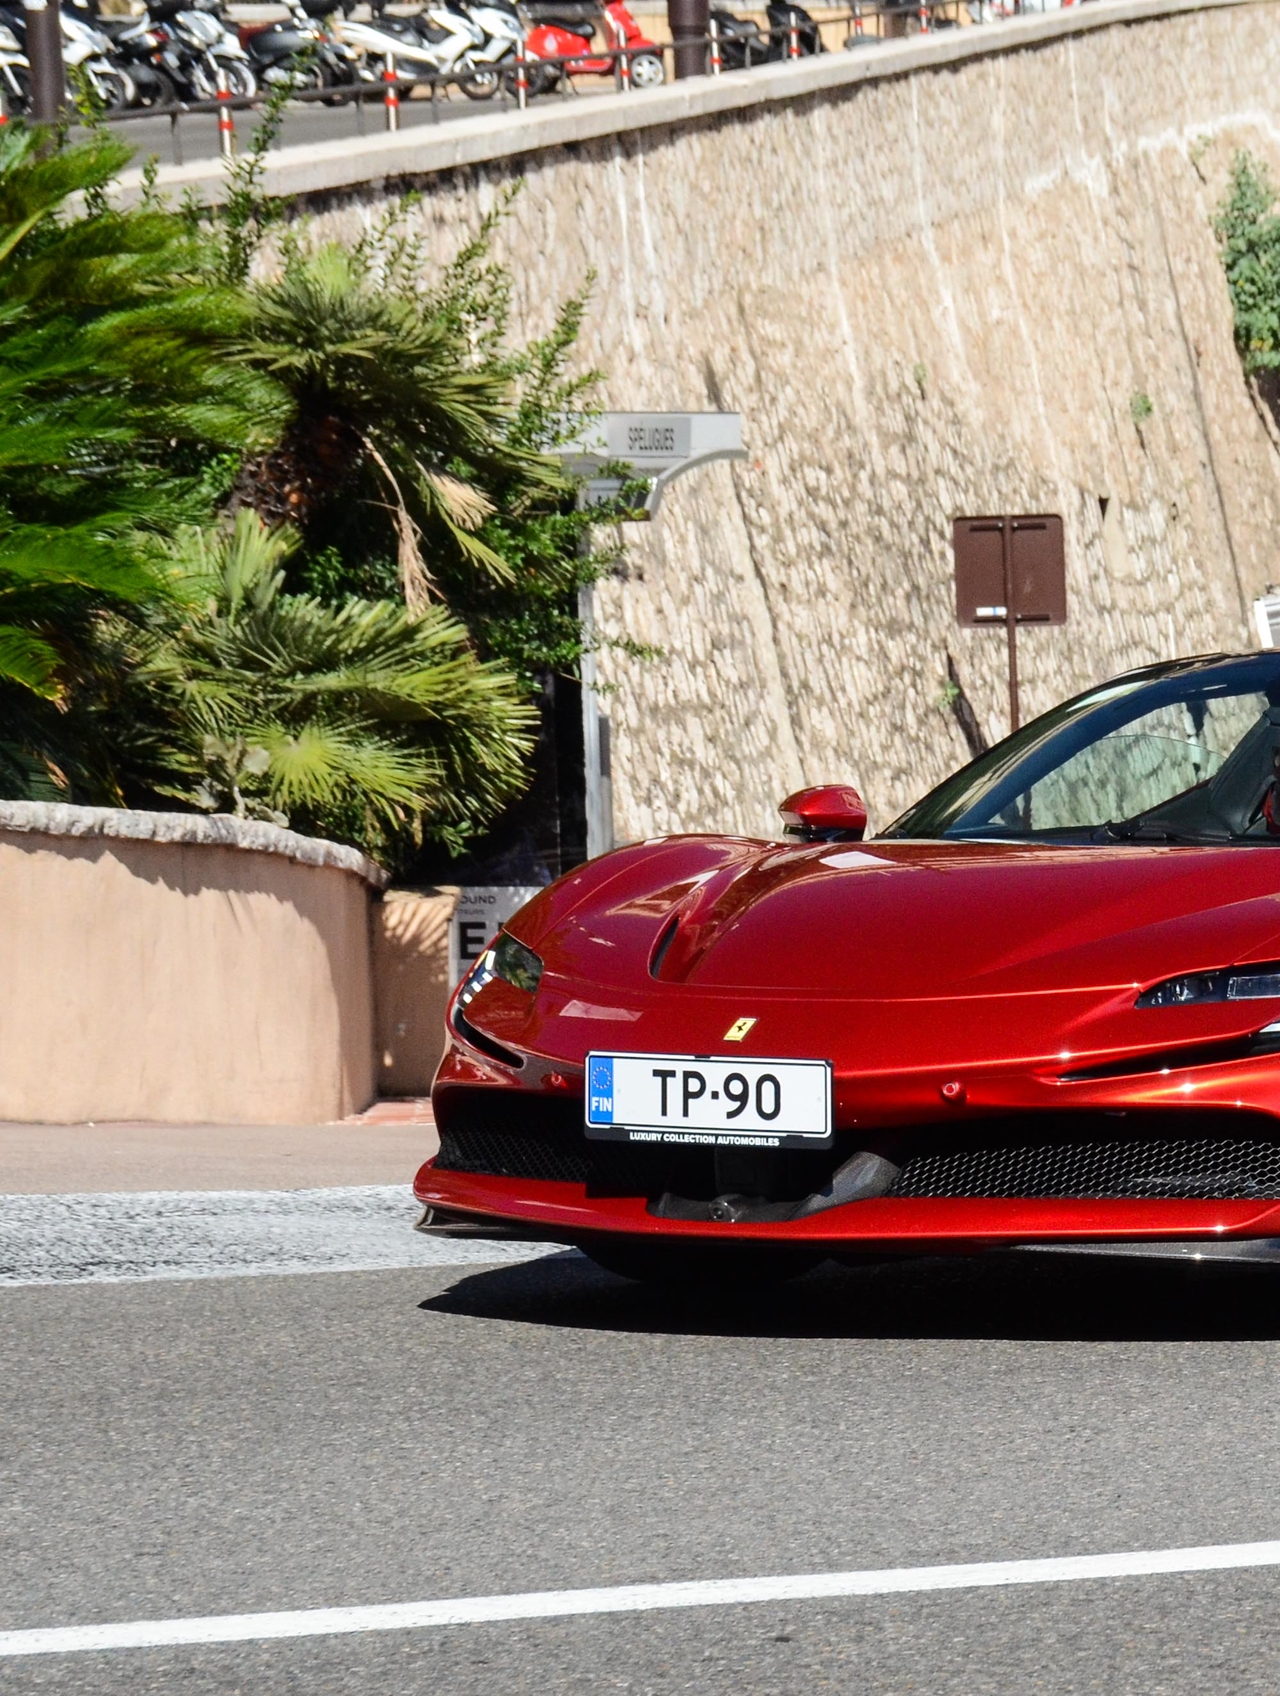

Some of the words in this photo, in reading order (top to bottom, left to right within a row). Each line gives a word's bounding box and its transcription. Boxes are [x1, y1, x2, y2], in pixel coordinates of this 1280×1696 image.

[591, 1096, 612, 1112] FIN
[629, 1131, 662, 1141] LUXURY
[663, 1133, 716, 1144] COLLECTION
[717, 1135, 780, 1147] AUTOMOBILES
